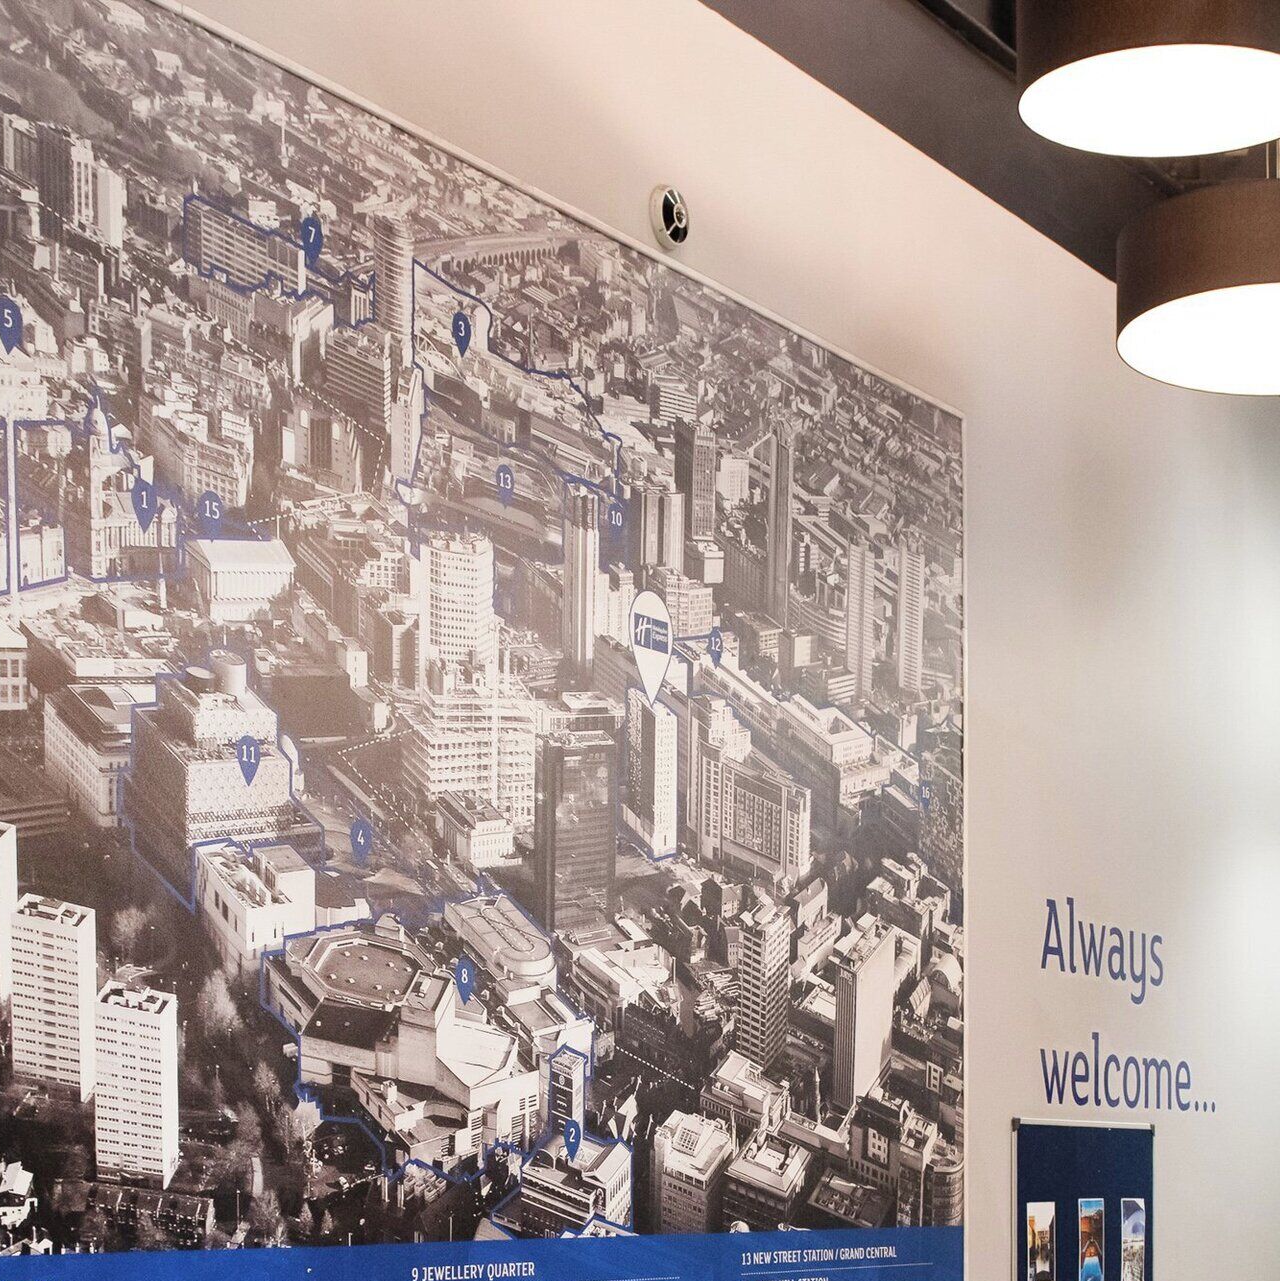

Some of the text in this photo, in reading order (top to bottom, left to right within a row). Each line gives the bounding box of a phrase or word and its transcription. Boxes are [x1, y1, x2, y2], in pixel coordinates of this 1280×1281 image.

[308, 225, 316, 243] 7
[3, 308, 13, 328] 5
[458, 320, 465, 337] 3
[499, 472, 512, 490] 13
[141, 490, 148, 509] 1
[204, 499, 220, 520] 15
[611, 510, 623, 527] 10
[711, 636, 721, 652] 12
[241, 744, 256, 764] 11
[357, 829, 365, 846] 4
[1040, 896, 1165, 1006] Always
[461, 968, 469, 984] 8
[1039, 1031, 1217, 1113] welcome...
[569, 1127, 576, 1143] 2
[741, 1245, 897, 1266] 13 NEW STREET STATION / GRAND CENTRAL
[421, 1264, 485, 1281] JEWELLERY
[486, 1261, 535, 1281] QUARTER
